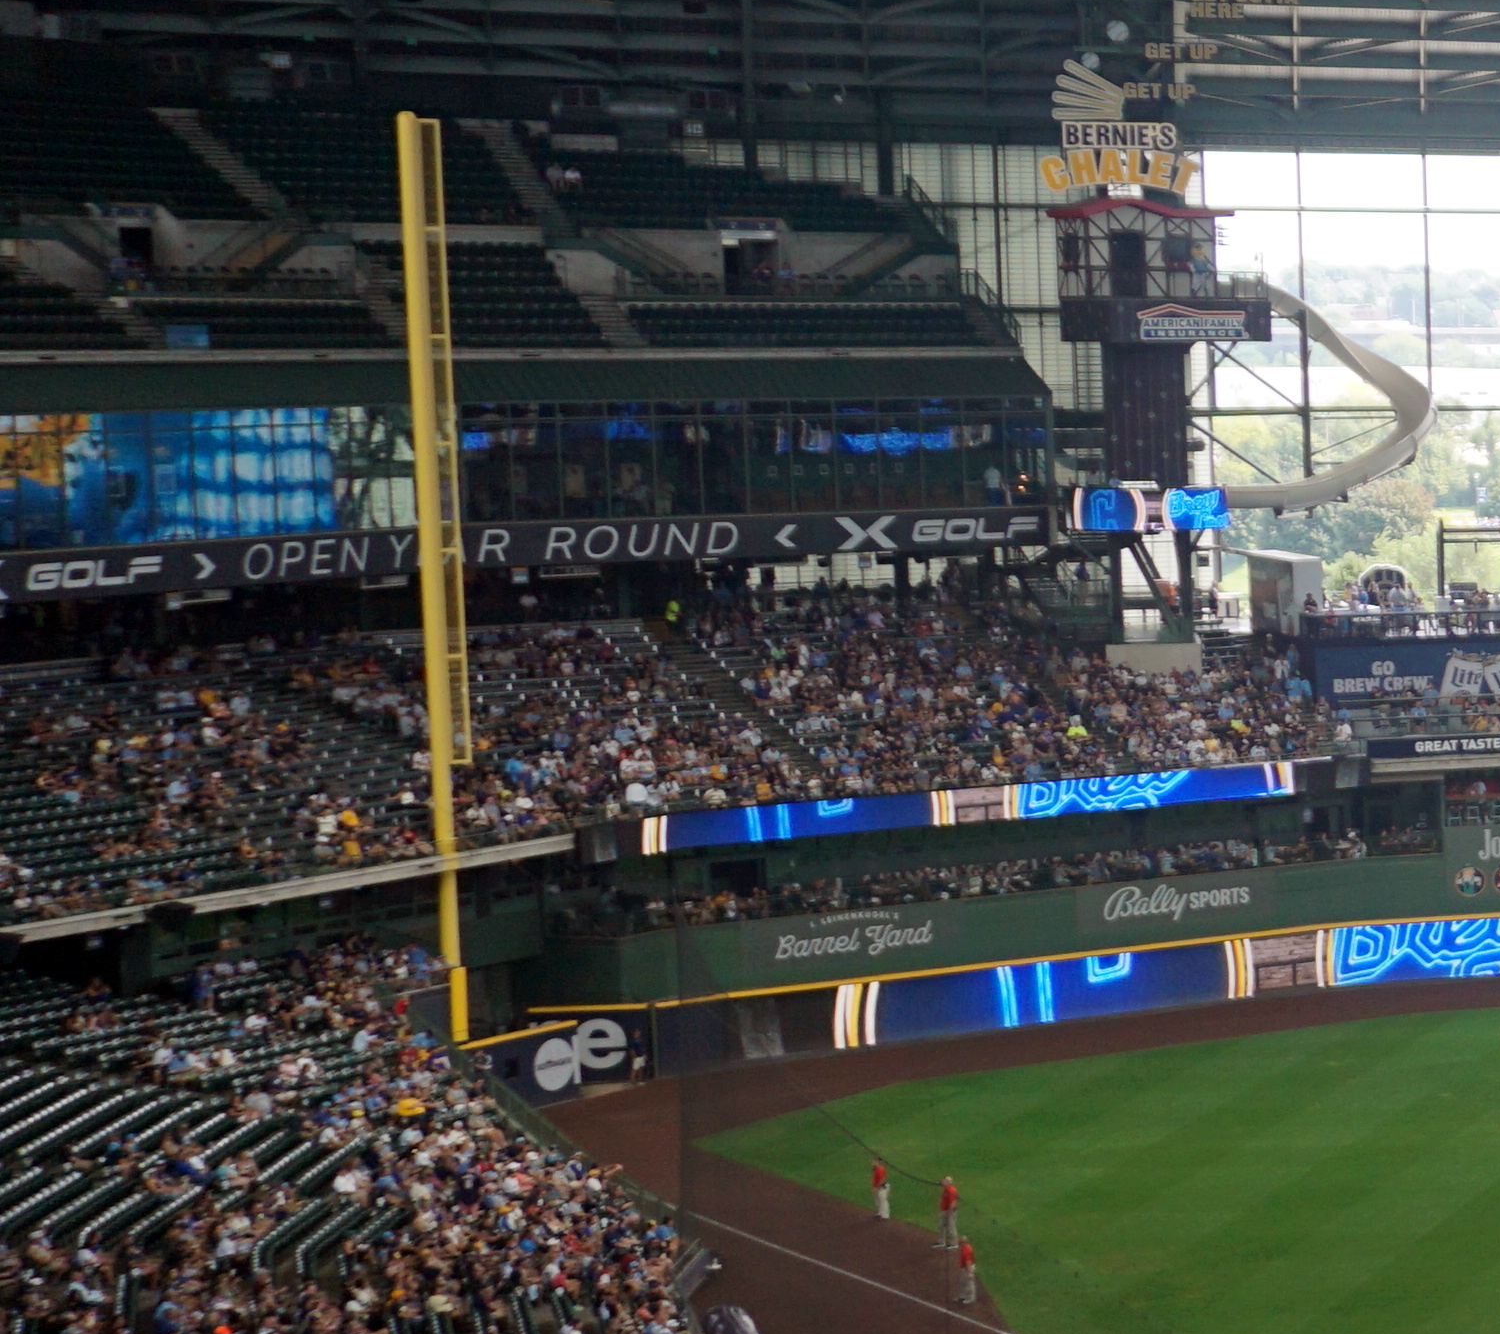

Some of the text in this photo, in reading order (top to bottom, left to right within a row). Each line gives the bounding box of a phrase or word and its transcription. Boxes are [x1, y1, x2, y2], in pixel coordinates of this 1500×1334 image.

[1189, 2, 1245, 19] HERE
[1144, 43, 1219, 60] GET UP
[1122, 82, 1196, 100] GET UP
[1064, 121, 1177, 149] BERNIE'S
[1039, 148, 1201, 195] CHALET
[1143, 317, 1243, 329] AMERICAN FAMILY
[835, 515, 1040, 551] X GOLF
[26, 555, 163, 591] GOLF
[1371, 660, 1395, 677] GO
[1103, 883, 1250, 921] Bally SPORTS
[775, 919, 933, 960] Barrel Yard
